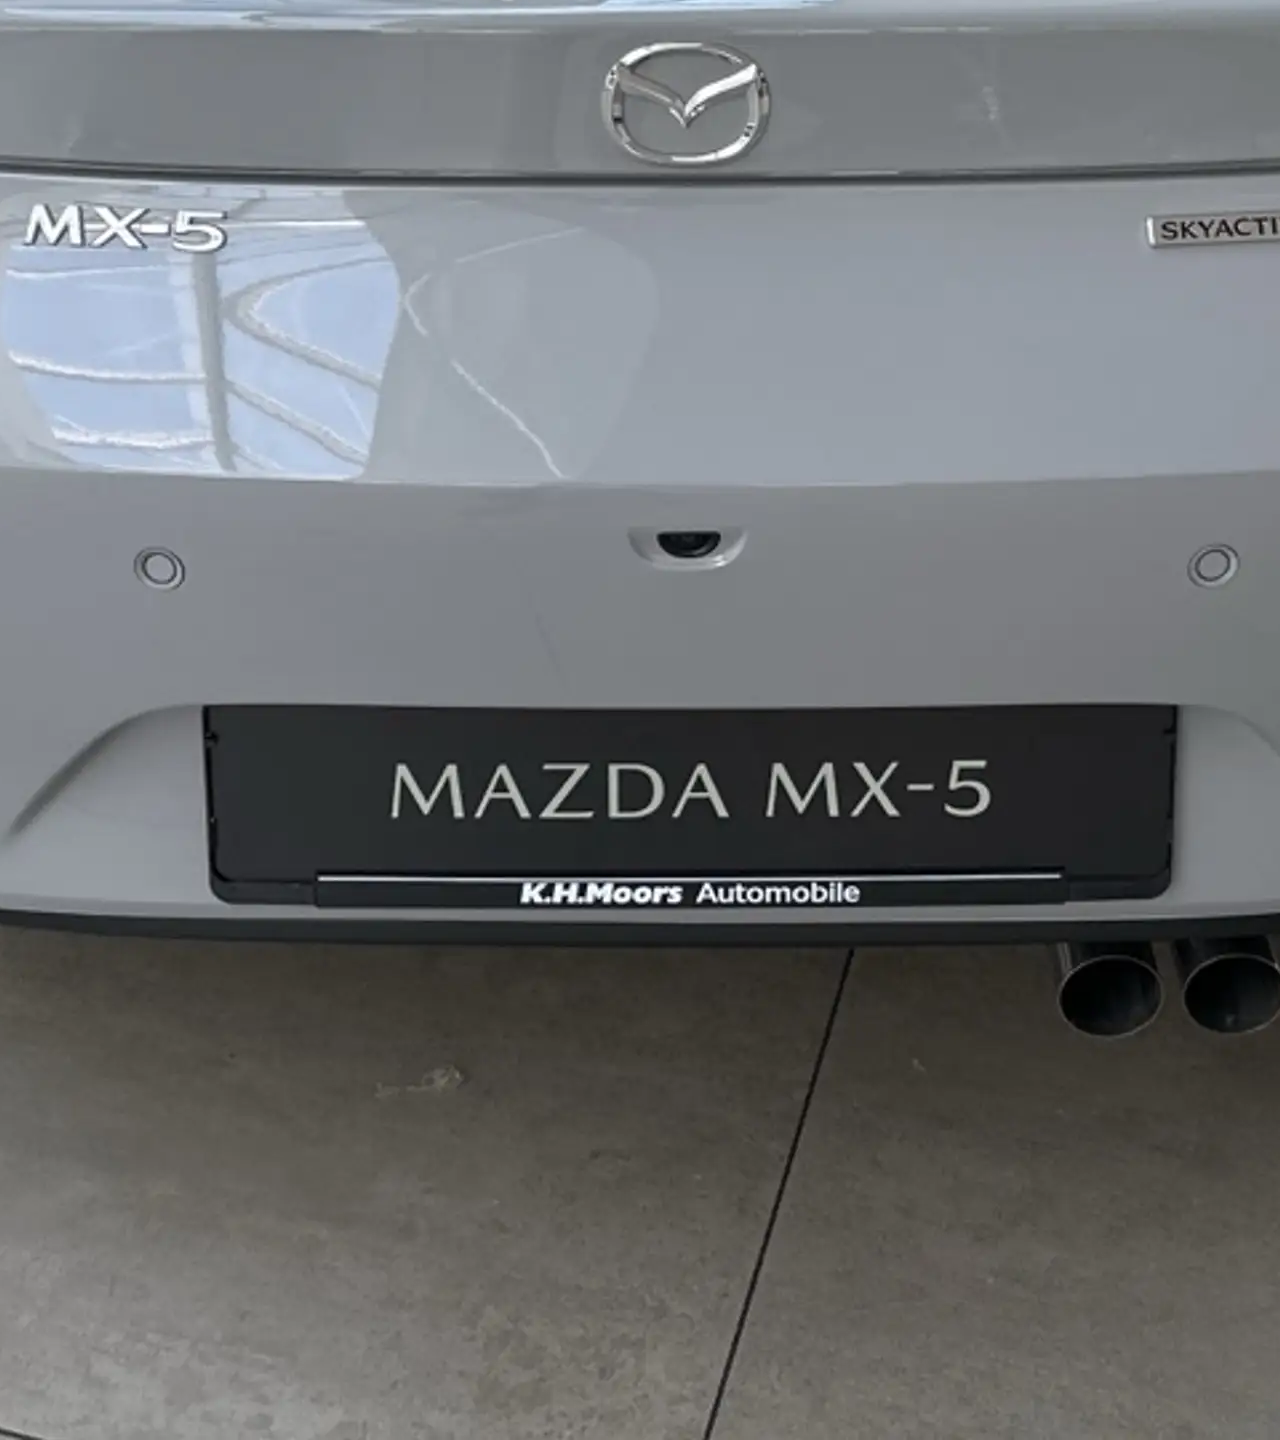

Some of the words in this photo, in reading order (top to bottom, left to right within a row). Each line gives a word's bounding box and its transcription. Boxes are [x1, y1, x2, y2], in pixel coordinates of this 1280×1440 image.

[23, 203, 229, 252] MX-5
[391, 762, 729, 820] MAZDA
[765, 760, 993, 819] MX-5
[520, 882, 683, 905] K.H.Moors
[696, 882, 861, 905] Automobile
